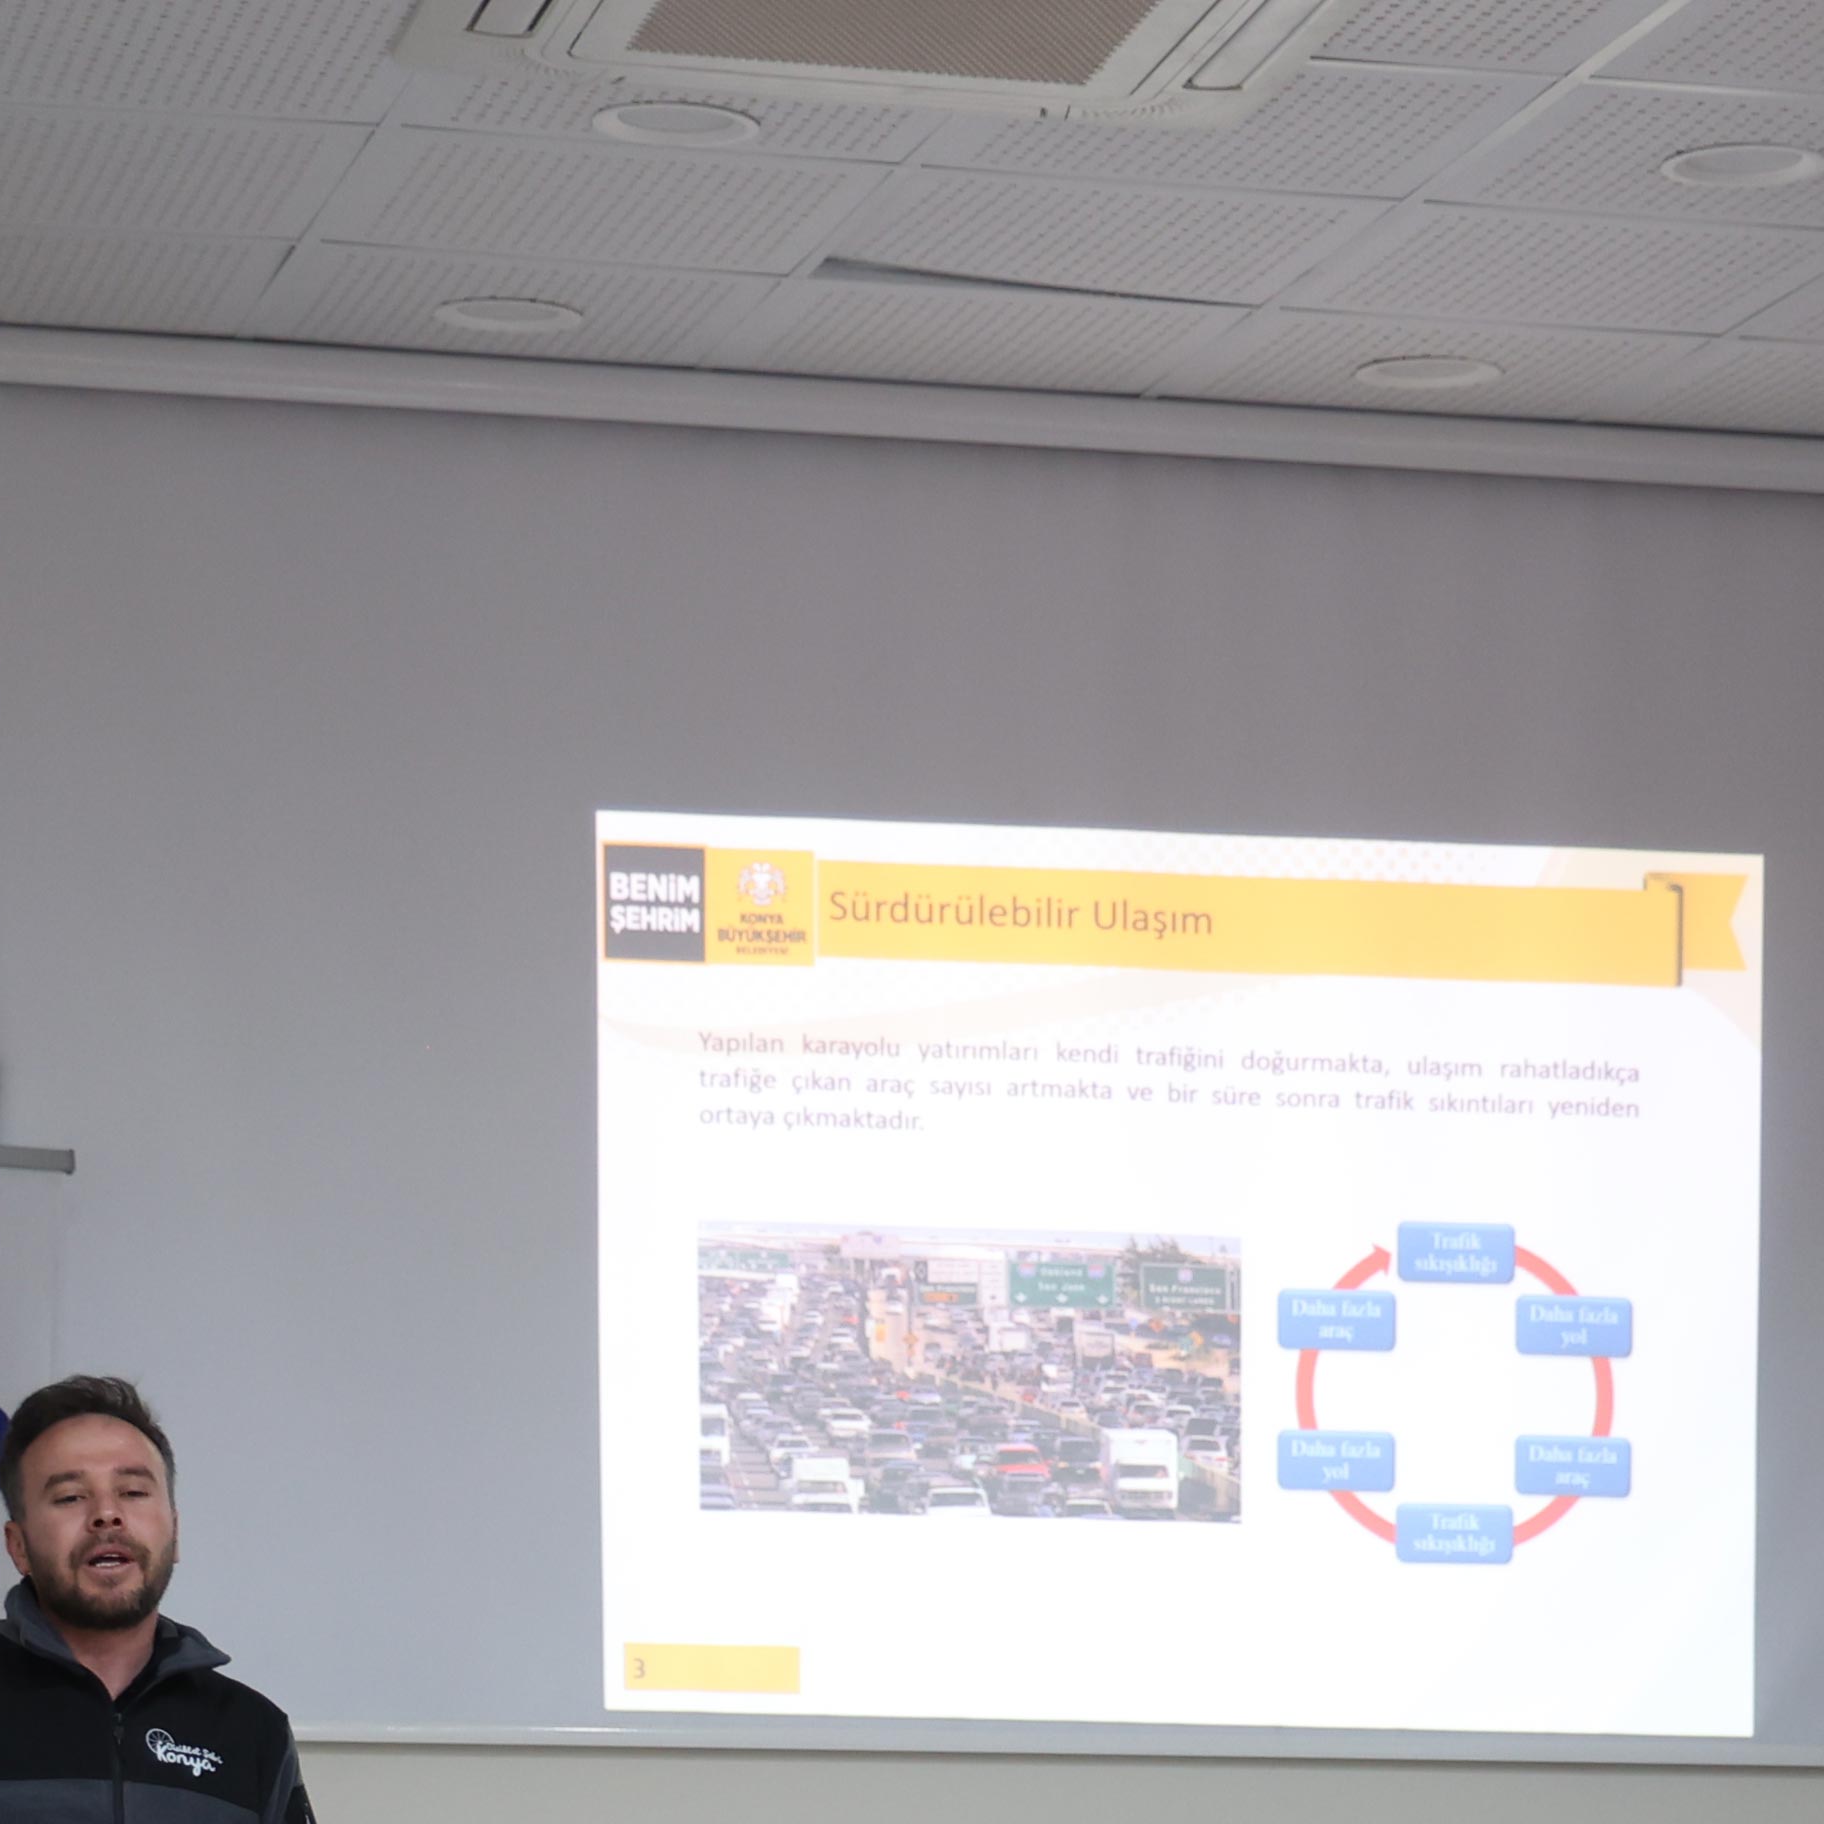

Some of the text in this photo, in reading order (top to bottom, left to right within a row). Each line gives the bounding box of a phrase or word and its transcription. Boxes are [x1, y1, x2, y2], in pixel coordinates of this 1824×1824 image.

[740, 913, 784, 924] KONYA
[830, 891, 1213, 940] Sürdürülebilir Ulaşım
[717, 925, 807, 943] BÜYÜKŞEHİR
[698, 1030, 1640, 1086] Yapılan karayolu yatırımları kendi trafiğini doğurmakta, ulaşım rahatladıkça
[699, 1067, 1640, 1119] trafiğe çıkan araç sayısı artmakta ve bir süre sonra trafik sıkıntıları yeniden
[699, 1105, 925, 1132] ortaya çıkmaktadır.
[1433, 1232, 1480, 1251] Trafik
[1292, 1298, 1381, 1318] Daha fazla
[1530, 1304, 1618, 1324] Daha fazla
[1319, 1322, 1354, 1341] araç
[1560, 1328, 1587, 1348] yol
[1291, 1439, 1381, 1458] Daha fazla
[1529, 1444, 1617, 1464] Daha fazla
[1322, 1463, 1349, 1482] yol
[1555, 1470, 1591, 1487] araç
[1431, 1512, 1480, 1530] Trafik
[633, 1658, 645, 1679] 3
[156, 1741, 217, 1777] Konya
